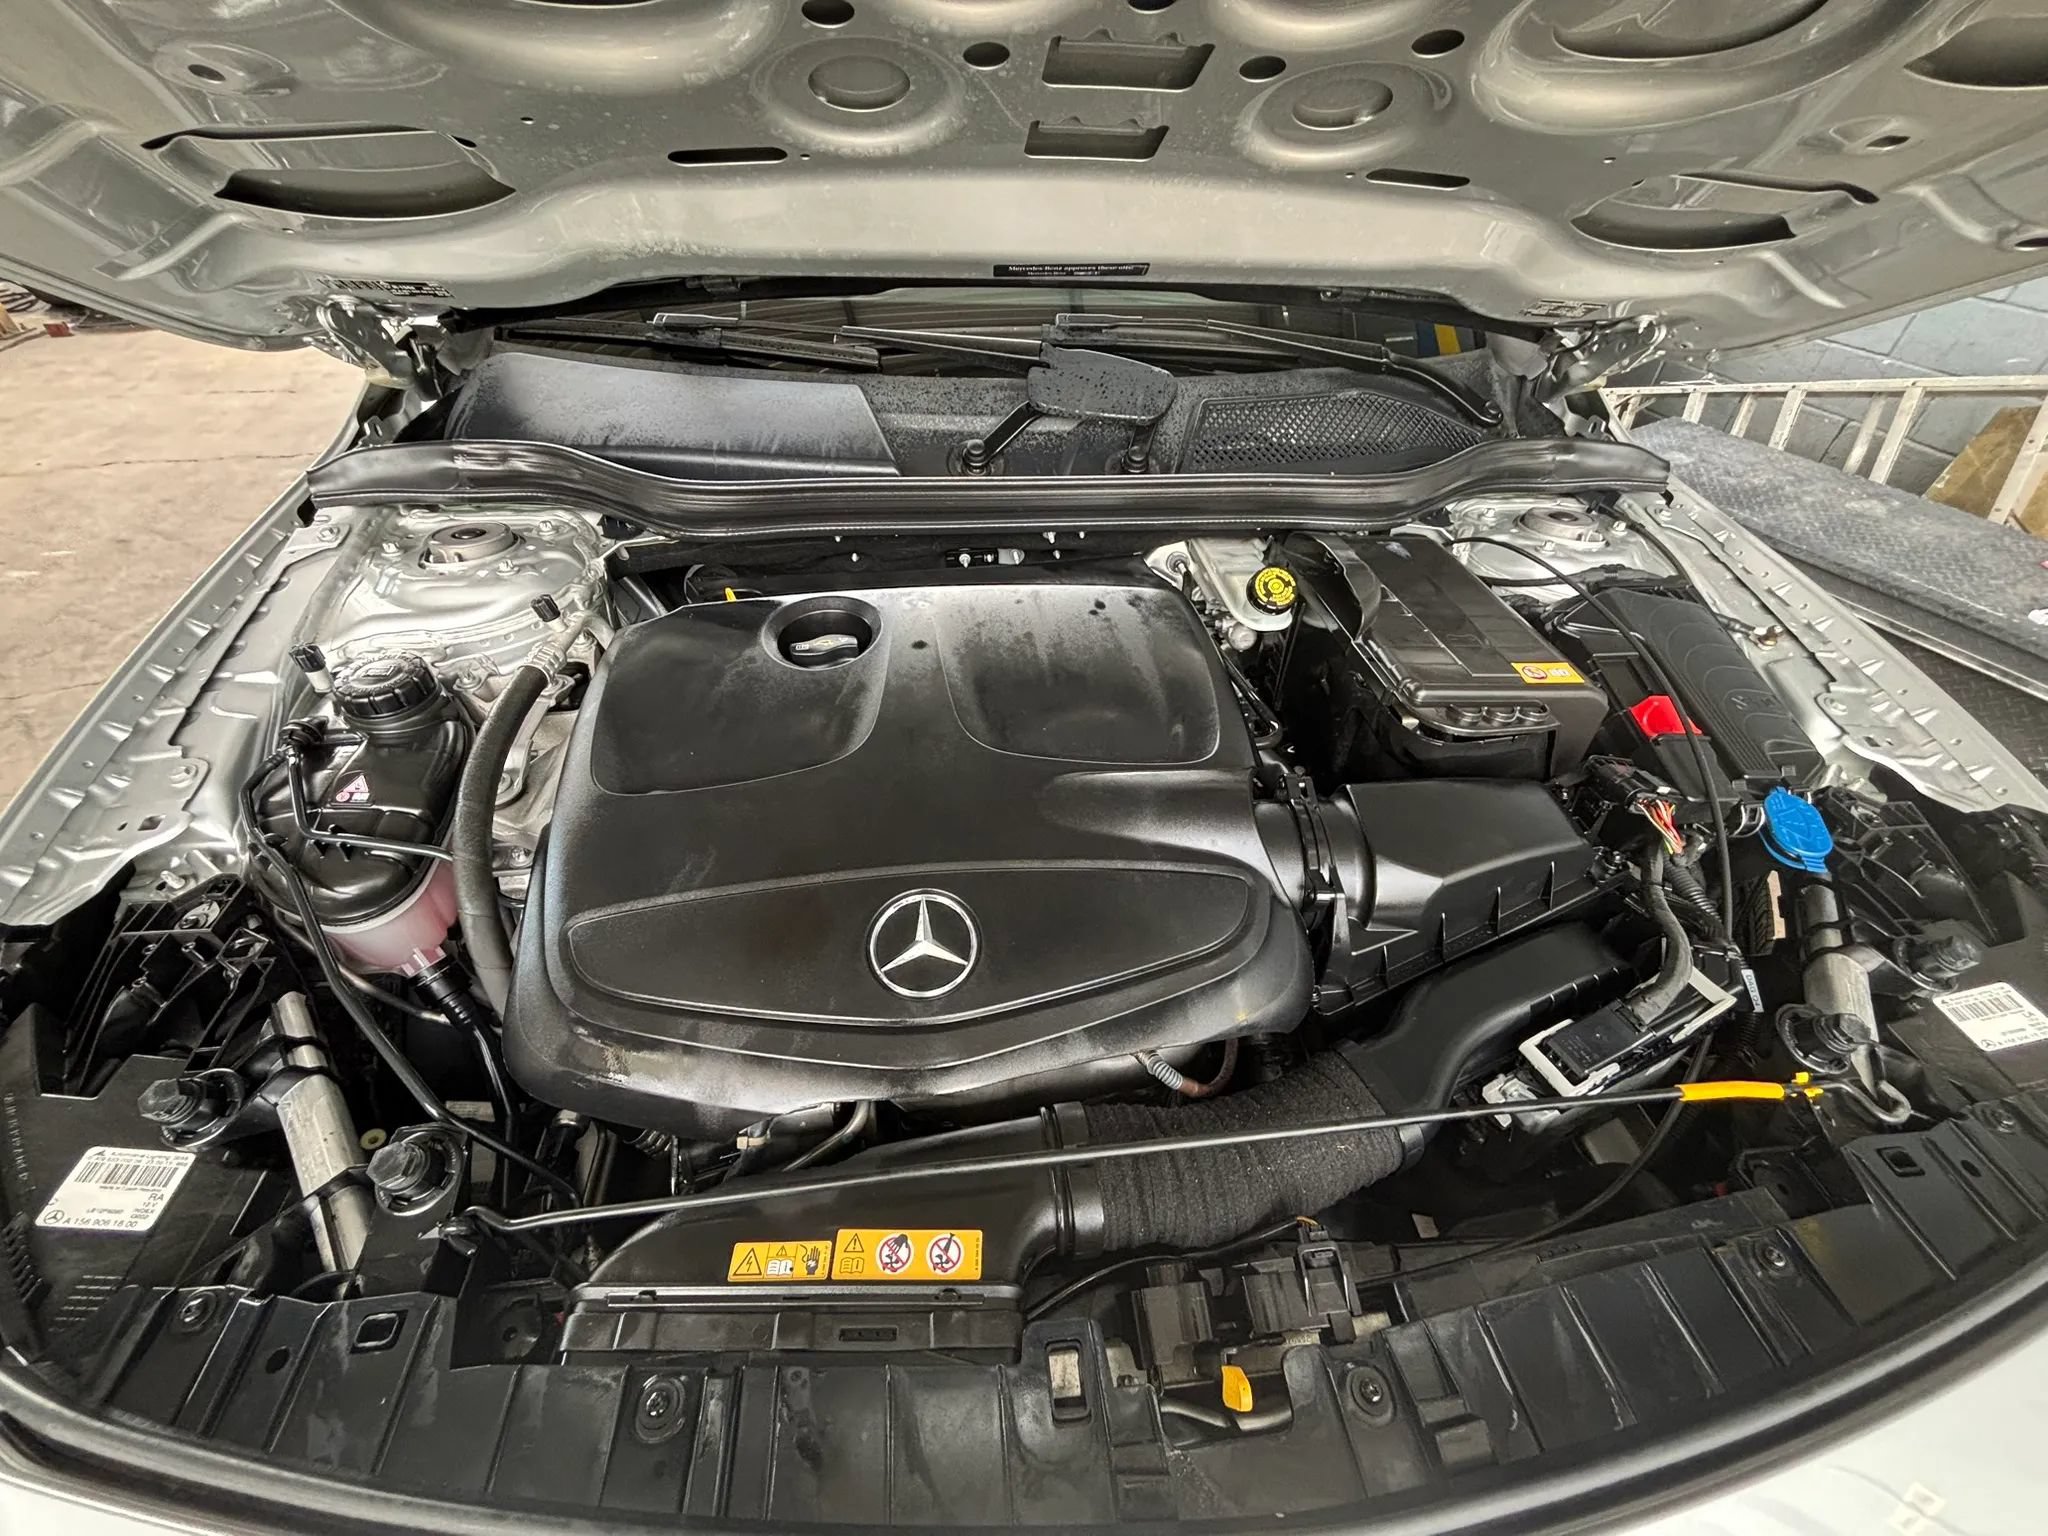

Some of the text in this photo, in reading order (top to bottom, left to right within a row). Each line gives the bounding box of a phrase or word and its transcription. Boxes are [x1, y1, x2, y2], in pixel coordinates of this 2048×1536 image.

[148, 1193, 165, 1201] RA
[75, 1218, 92, 1226] 156
[124, 1220, 139, 1228] 00
